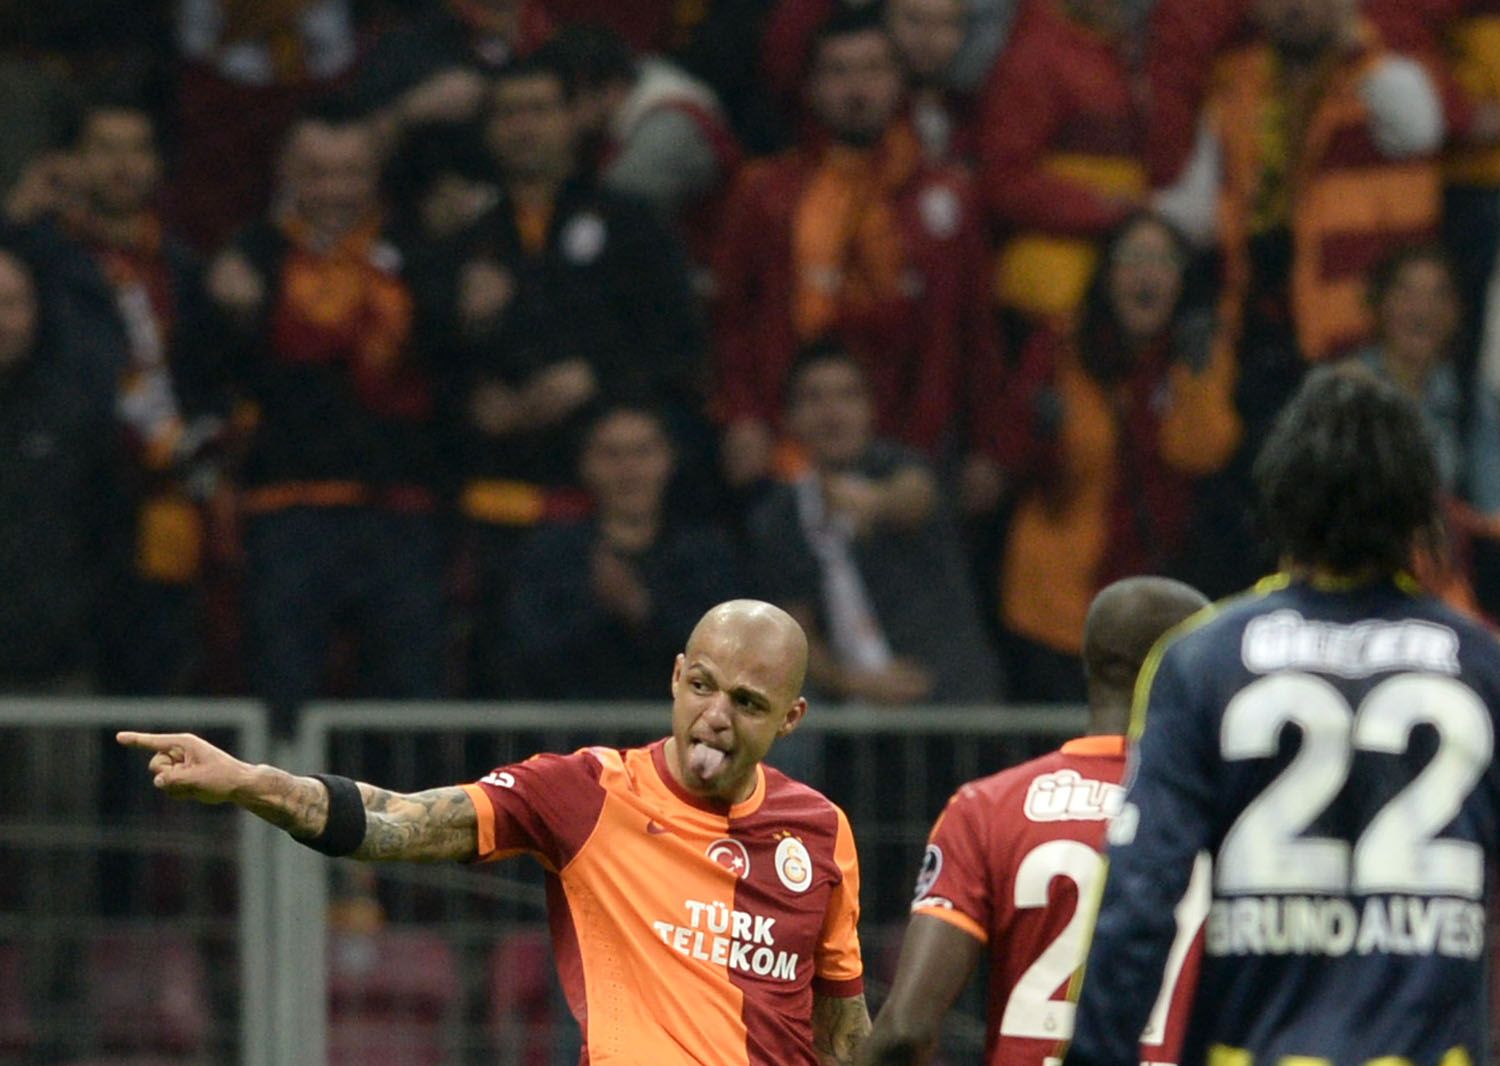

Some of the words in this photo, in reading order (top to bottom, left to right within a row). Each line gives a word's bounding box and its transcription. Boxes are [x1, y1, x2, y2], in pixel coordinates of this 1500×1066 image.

[1214, 671, 1496, 897] 22
[653, 920, 799, 981] TELEKOM
[685, 899, 776, 946] TÜRK
[1206, 897, 1356, 957] BRUNO
[1356, 897, 1486, 961] ALVES
